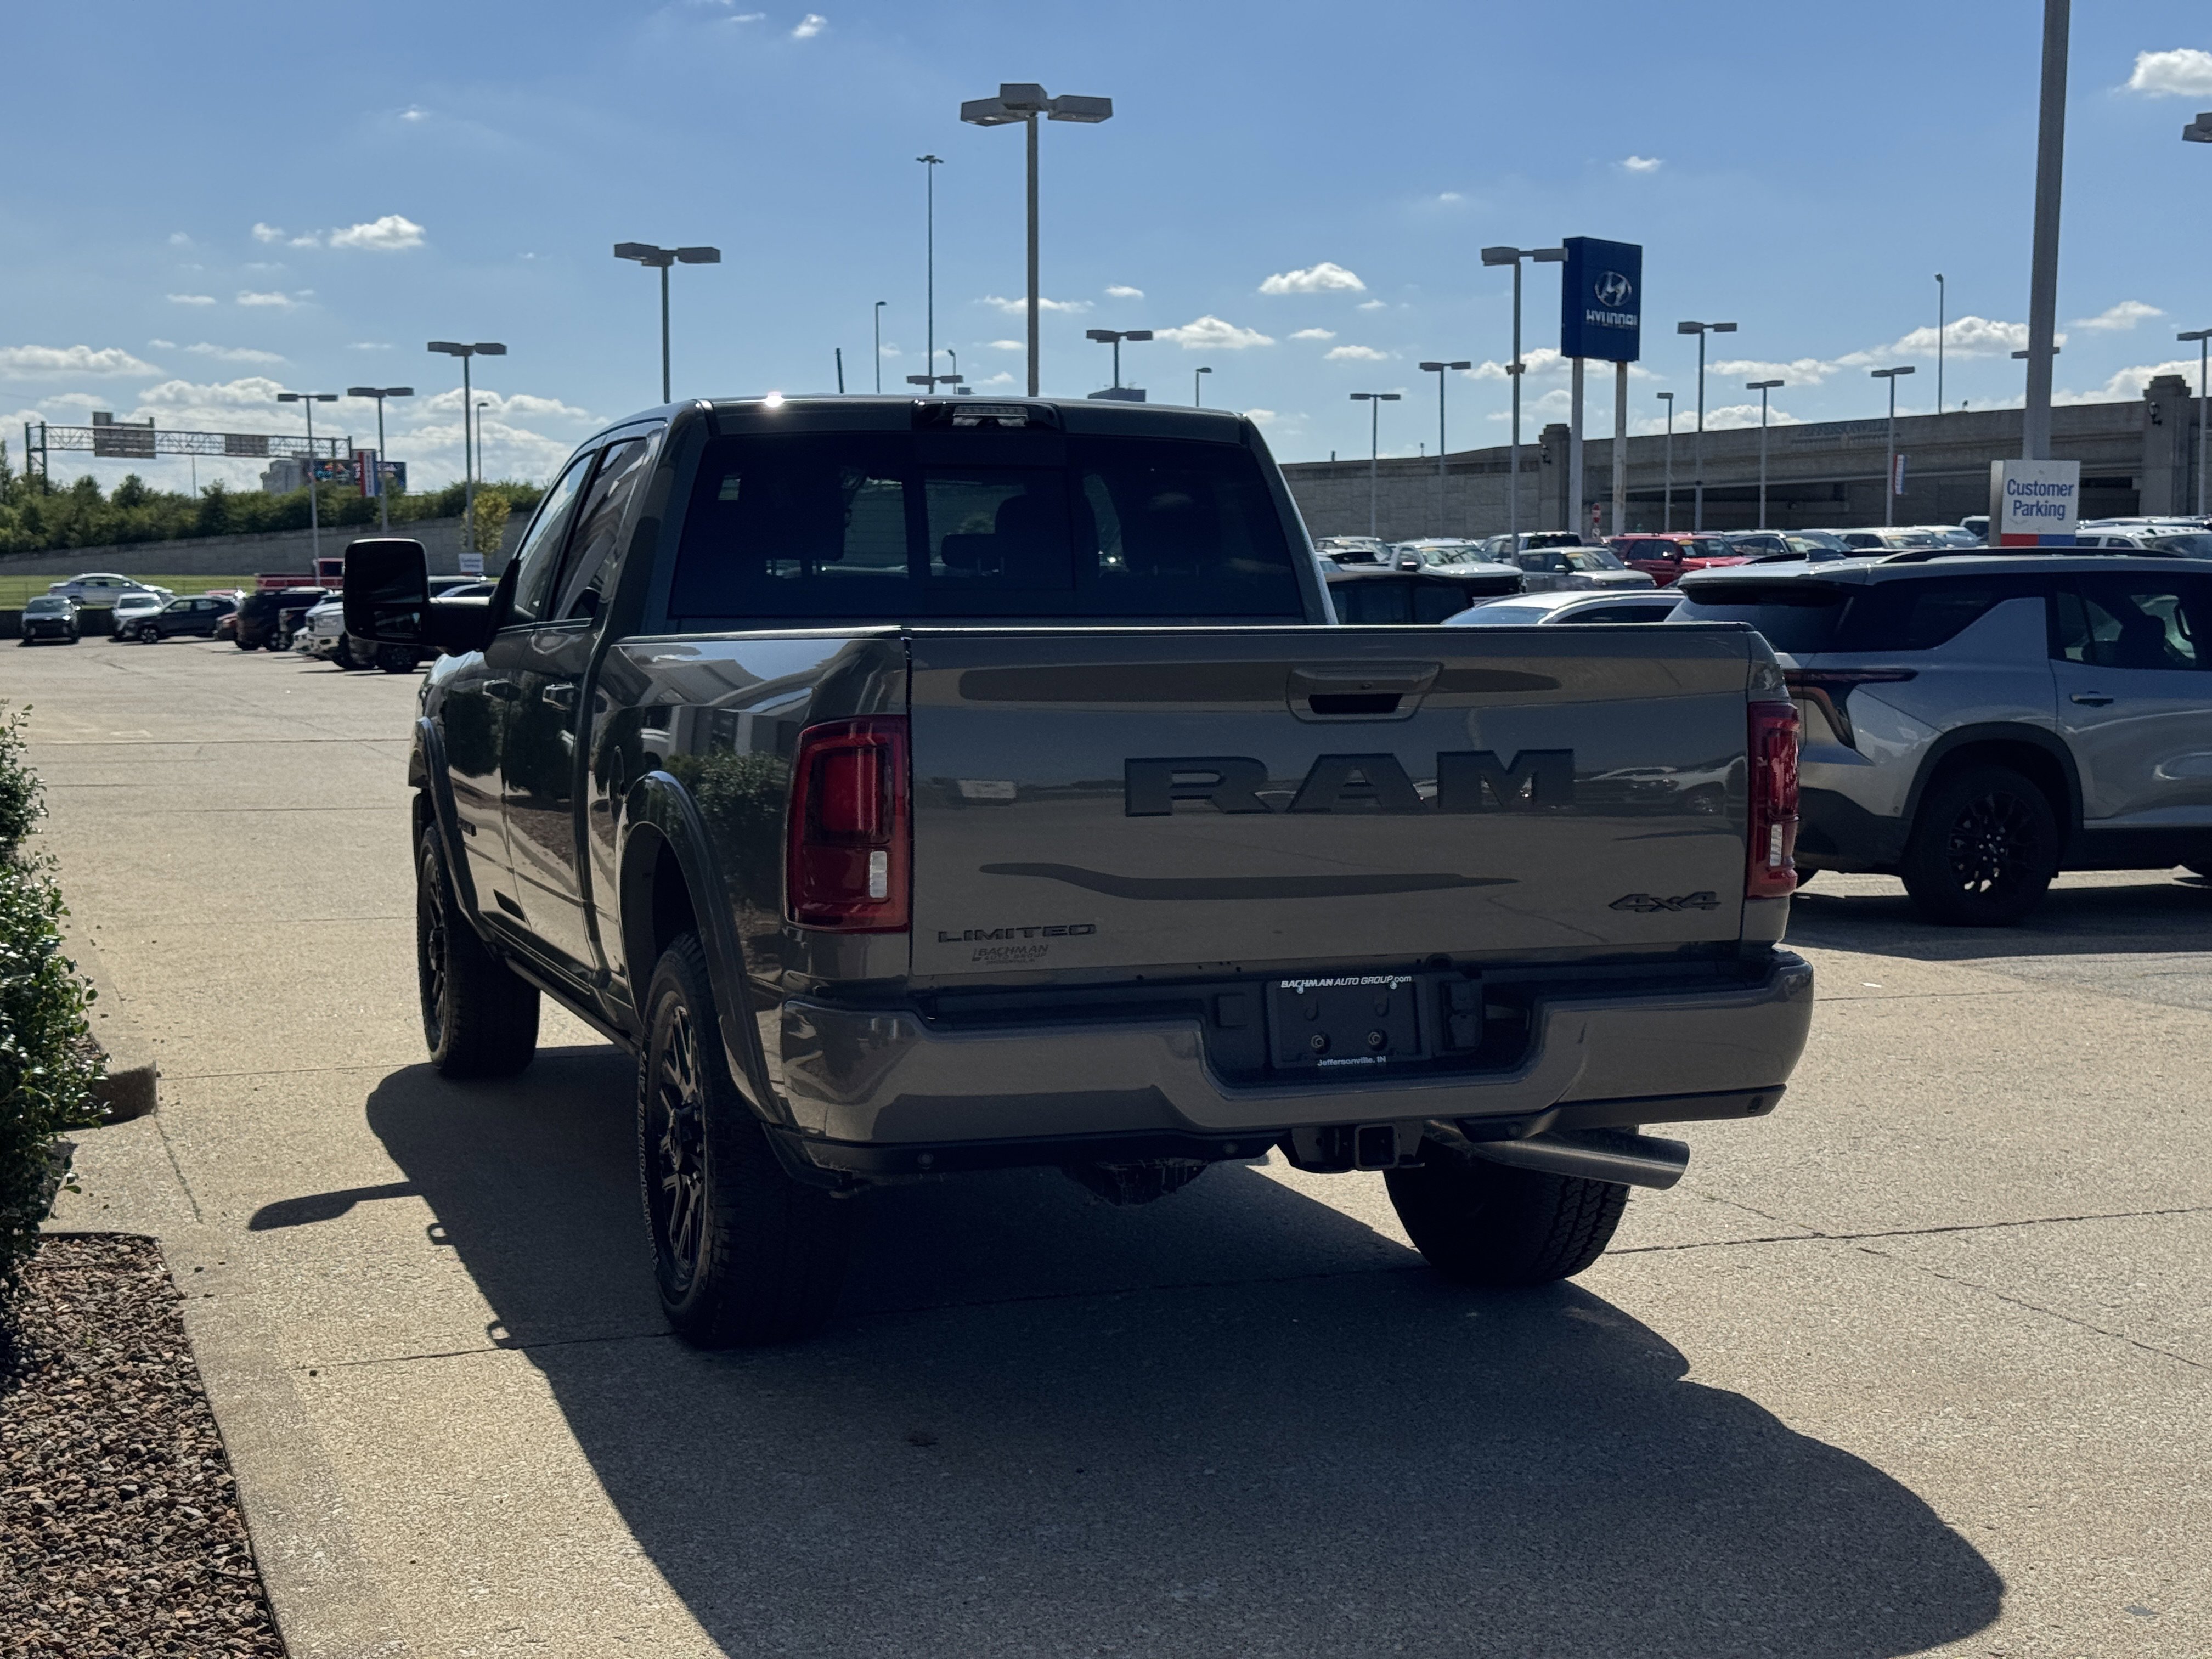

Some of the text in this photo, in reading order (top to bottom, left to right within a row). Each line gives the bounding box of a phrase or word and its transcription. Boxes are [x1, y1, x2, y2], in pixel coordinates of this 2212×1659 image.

[1586, 309, 1637, 325] HYUNDAI
[2007, 479, 2074, 496] Customer
[2013, 500, 2066, 521] Parking
[1125, 748, 1576, 817] RAM
[938, 924, 1096, 943] LIMITED
[978, 945, 1049, 956] BACHMAN
[1280, 979, 1334, 988] BACHMAN
[1333, 978, 1359, 986] AUTO
